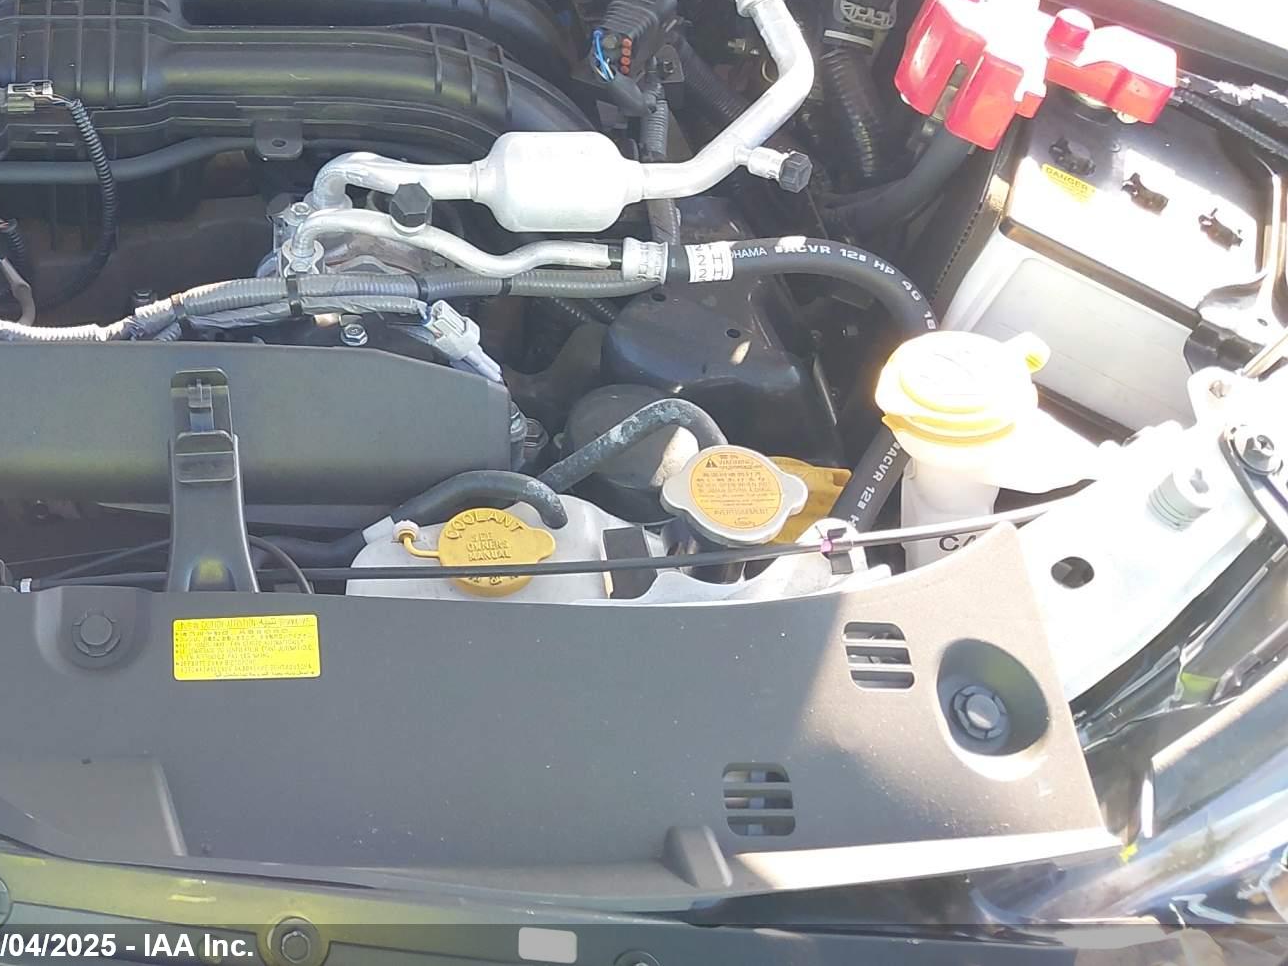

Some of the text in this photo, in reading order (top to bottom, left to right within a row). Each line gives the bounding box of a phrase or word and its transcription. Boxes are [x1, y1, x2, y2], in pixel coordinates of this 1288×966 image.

[873, 260, 896, 275] HP
[445, 510, 524, 540] COOLANT
[468, 549, 512, 562] MANUAL
